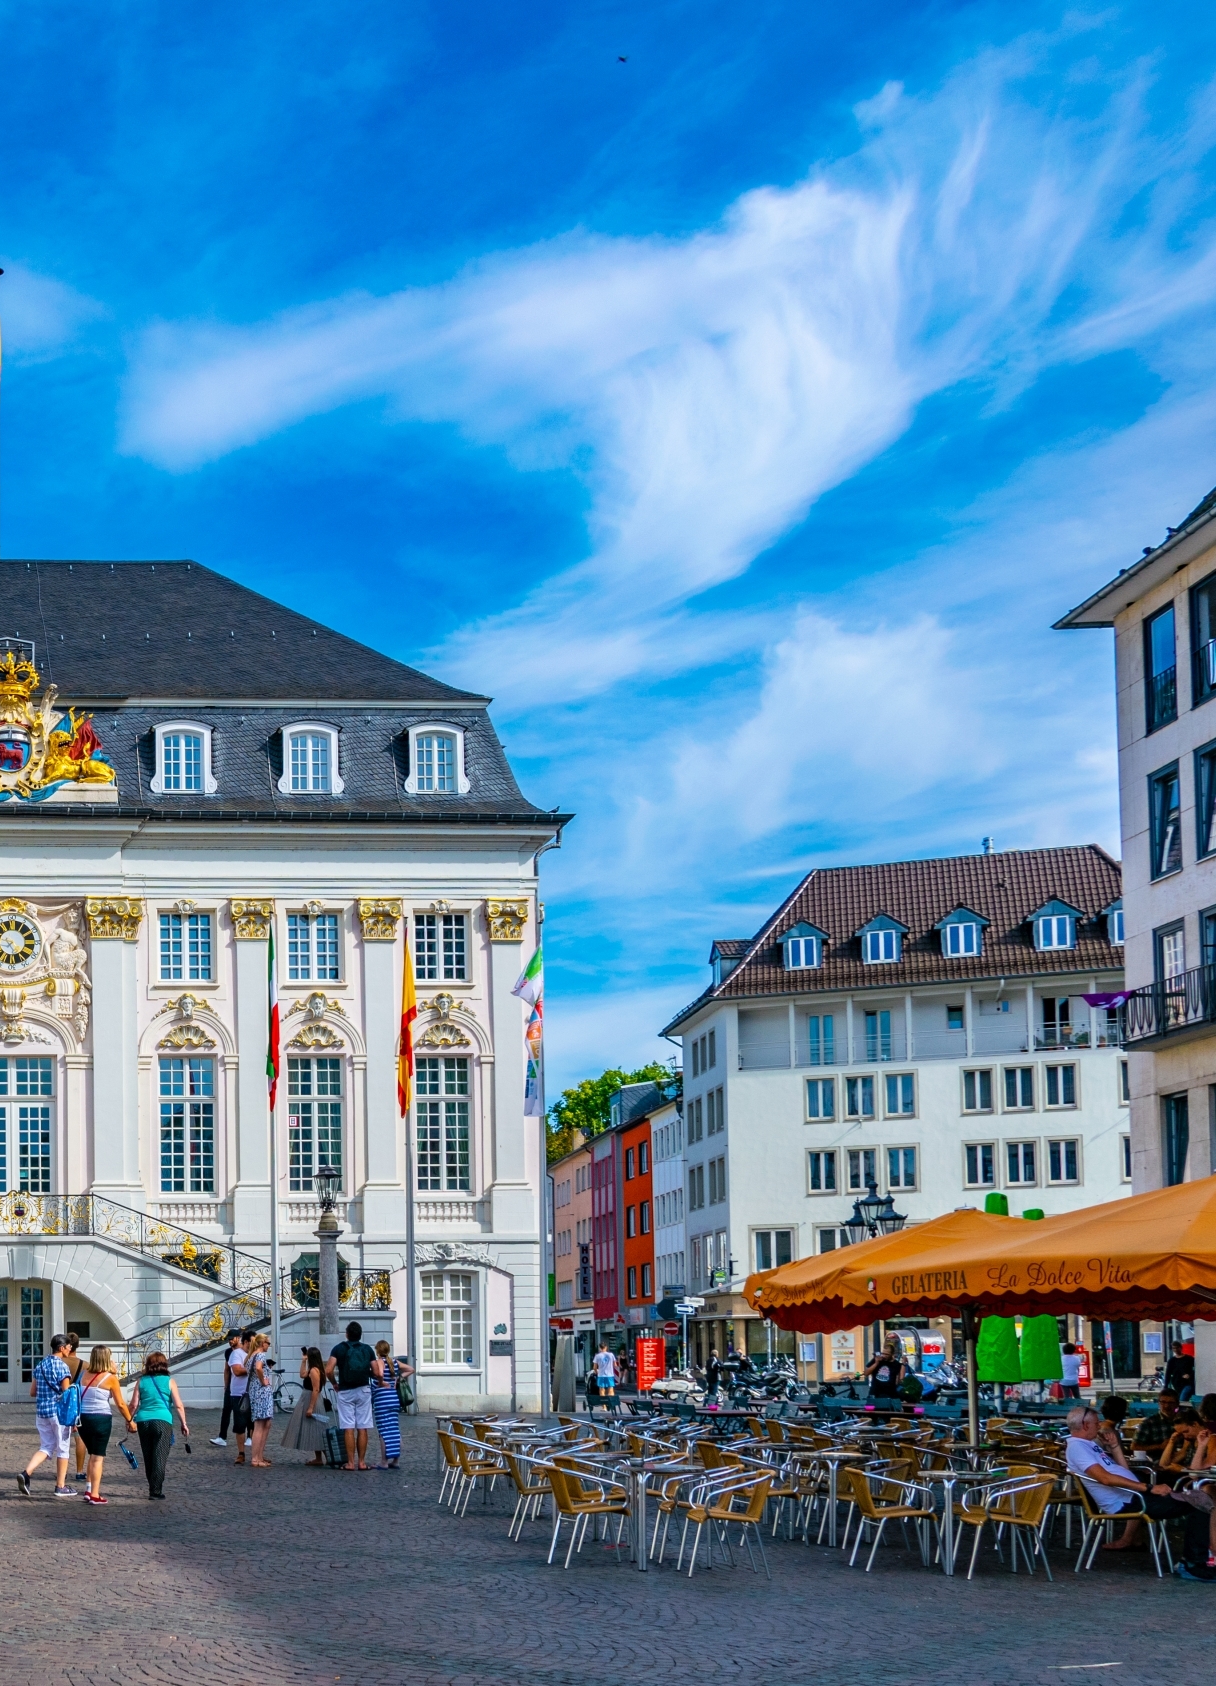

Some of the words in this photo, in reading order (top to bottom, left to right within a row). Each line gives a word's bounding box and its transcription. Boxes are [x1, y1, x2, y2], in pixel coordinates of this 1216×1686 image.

[581, 1245, 589, 1295] HOTEL
[891, 1269, 969, 1296] GELATERIA
[987, 1263, 1021, 1288] La
[1027, 1260, 1084, 1287] Dolce
[1086, 1258, 1134, 1285] Vita
